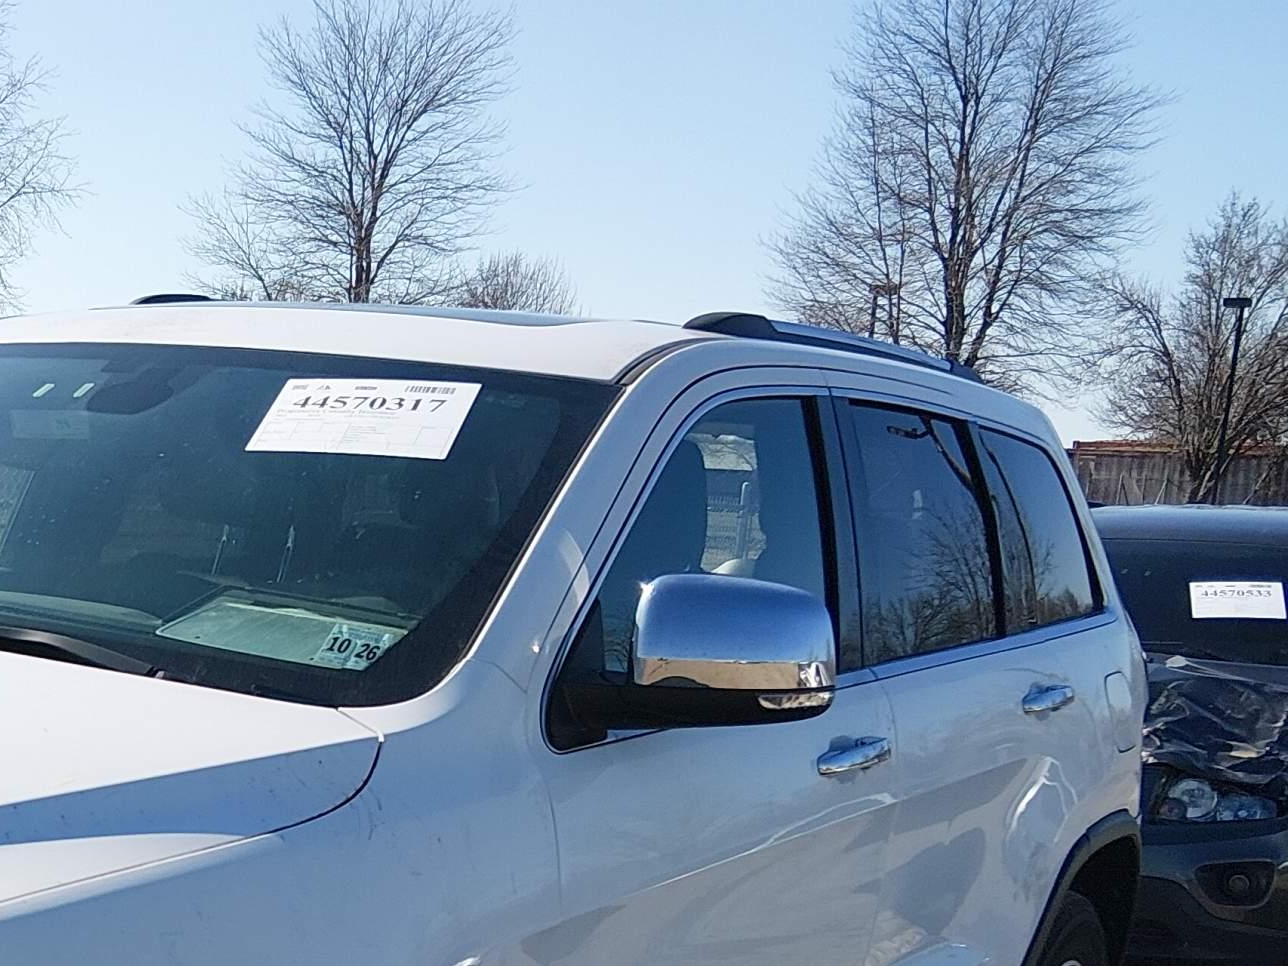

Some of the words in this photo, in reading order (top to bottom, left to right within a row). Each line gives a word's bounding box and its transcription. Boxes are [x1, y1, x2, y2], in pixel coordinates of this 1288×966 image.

[293, 395, 448, 413] 44570317
[1200, 589, 1273, 598] 44570533
[326, 635, 352, 655] 10
[353, 642, 381, 661] 26
